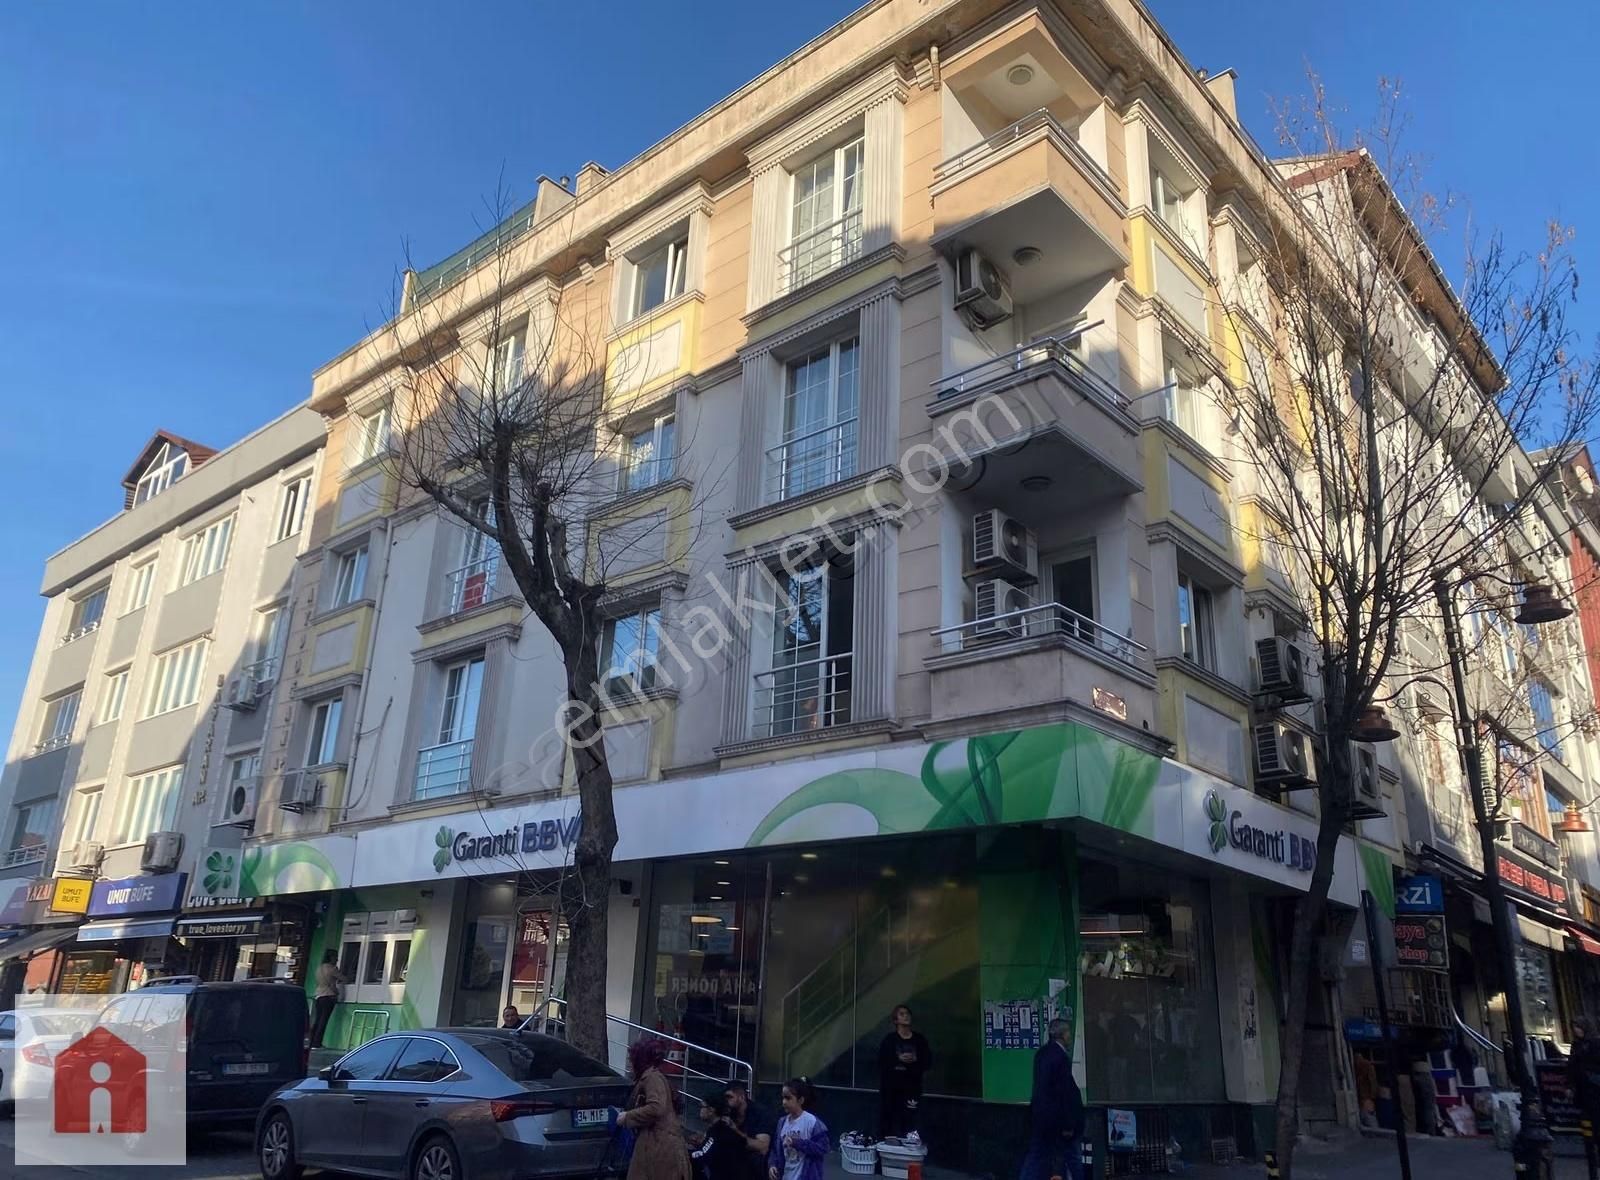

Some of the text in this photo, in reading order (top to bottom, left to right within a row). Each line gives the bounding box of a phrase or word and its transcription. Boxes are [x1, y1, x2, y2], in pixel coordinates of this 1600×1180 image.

[453, 825, 519, 861] Garanti
[1230, 810, 1285, 863] Garanti
[62, 887, 84, 896] UMUT
[107, 883, 155, 905] UMUT BÜFE
[1399, 945, 1429, 964] shop
[577, 1110, 587, 1122] 34
